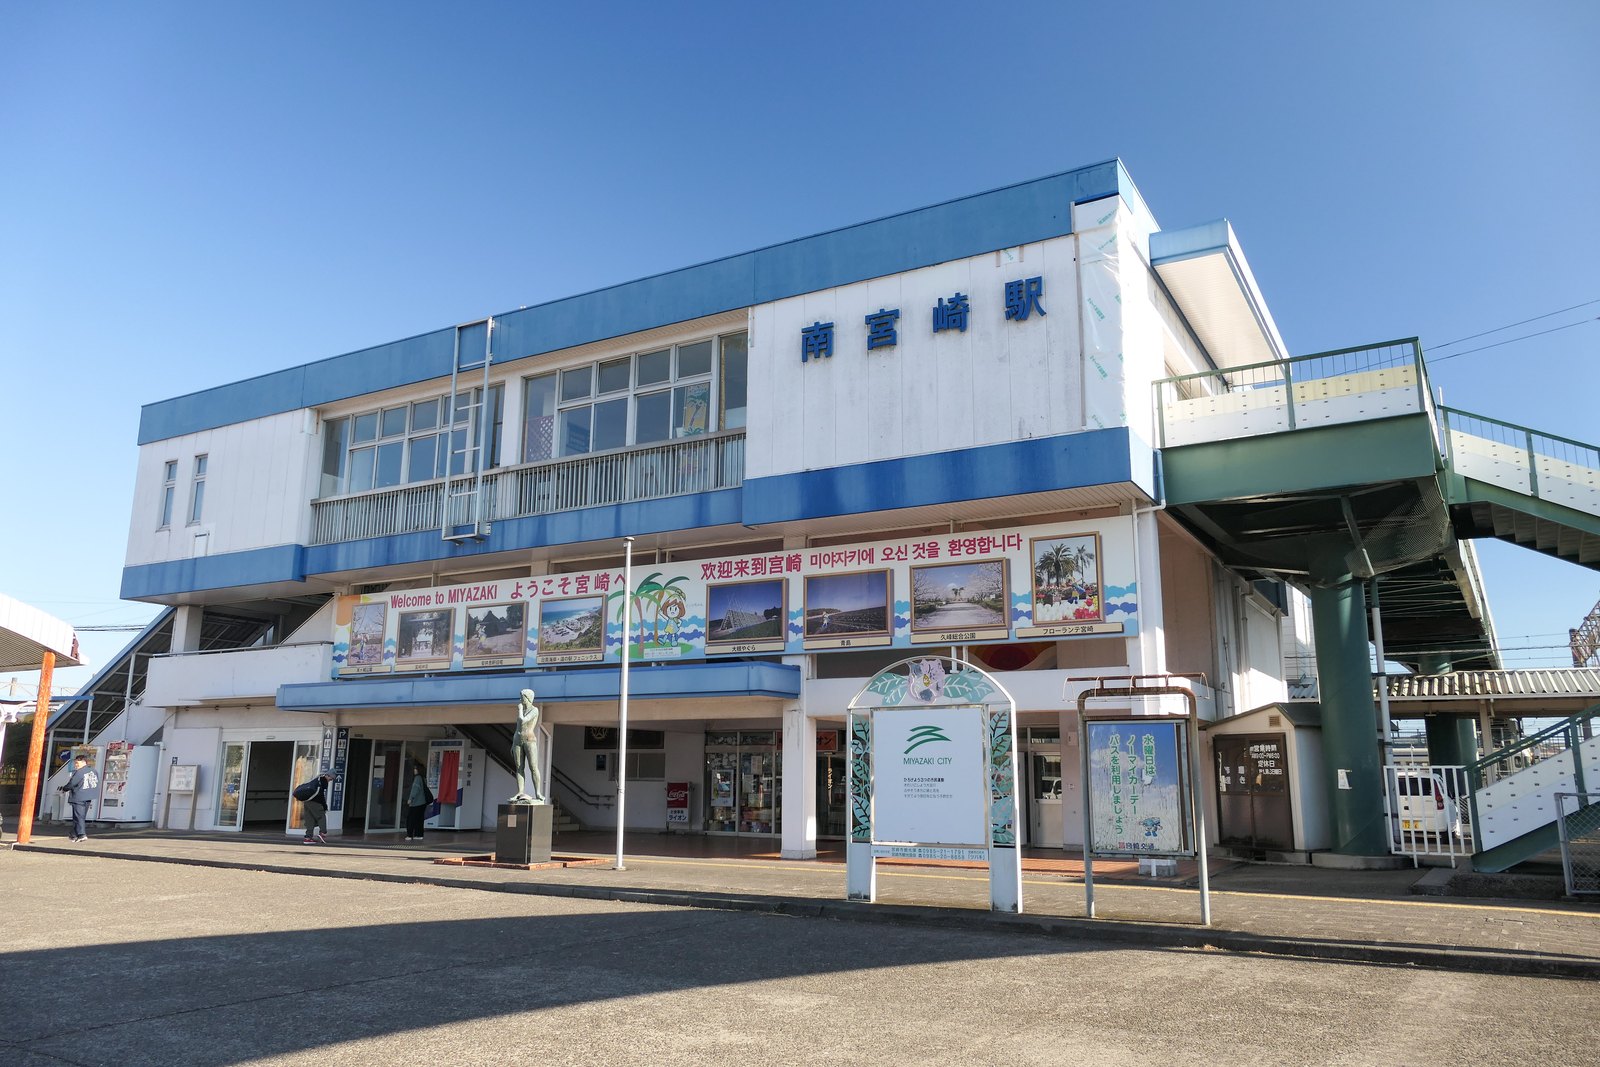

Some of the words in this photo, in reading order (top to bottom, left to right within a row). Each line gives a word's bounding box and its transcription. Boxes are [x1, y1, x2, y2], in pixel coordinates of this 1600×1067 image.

[801, 276, 1046, 362] 南宮崎駅
[810, 547, 875, 569] 미야자키에
[881, 544, 908, 561] 오신
[912, 541, 941, 560] 것을
[948, 533, 1023, 557] 환영합니다
[391, 594, 431, 609] Welcome
[435, 591, 445, 605] to
[448, 584, 498, 604] MIYAZAKI
[940, 632, 976, 640] 久峰総合公園
[1042, 625, 1094, 635] フローランテ宮崎
[903, 757, 935, 765] MIYAZAKI
[937, 757, 953, 765] CITY
[1143, 735, 1155, 775] 水曜日は
[1257, 760, 1275, 768] 定休日
[1110, 736, 1123, 834] バスを利用しましょう
[1127, 736, 1139, 814] ノーマイカーデー
